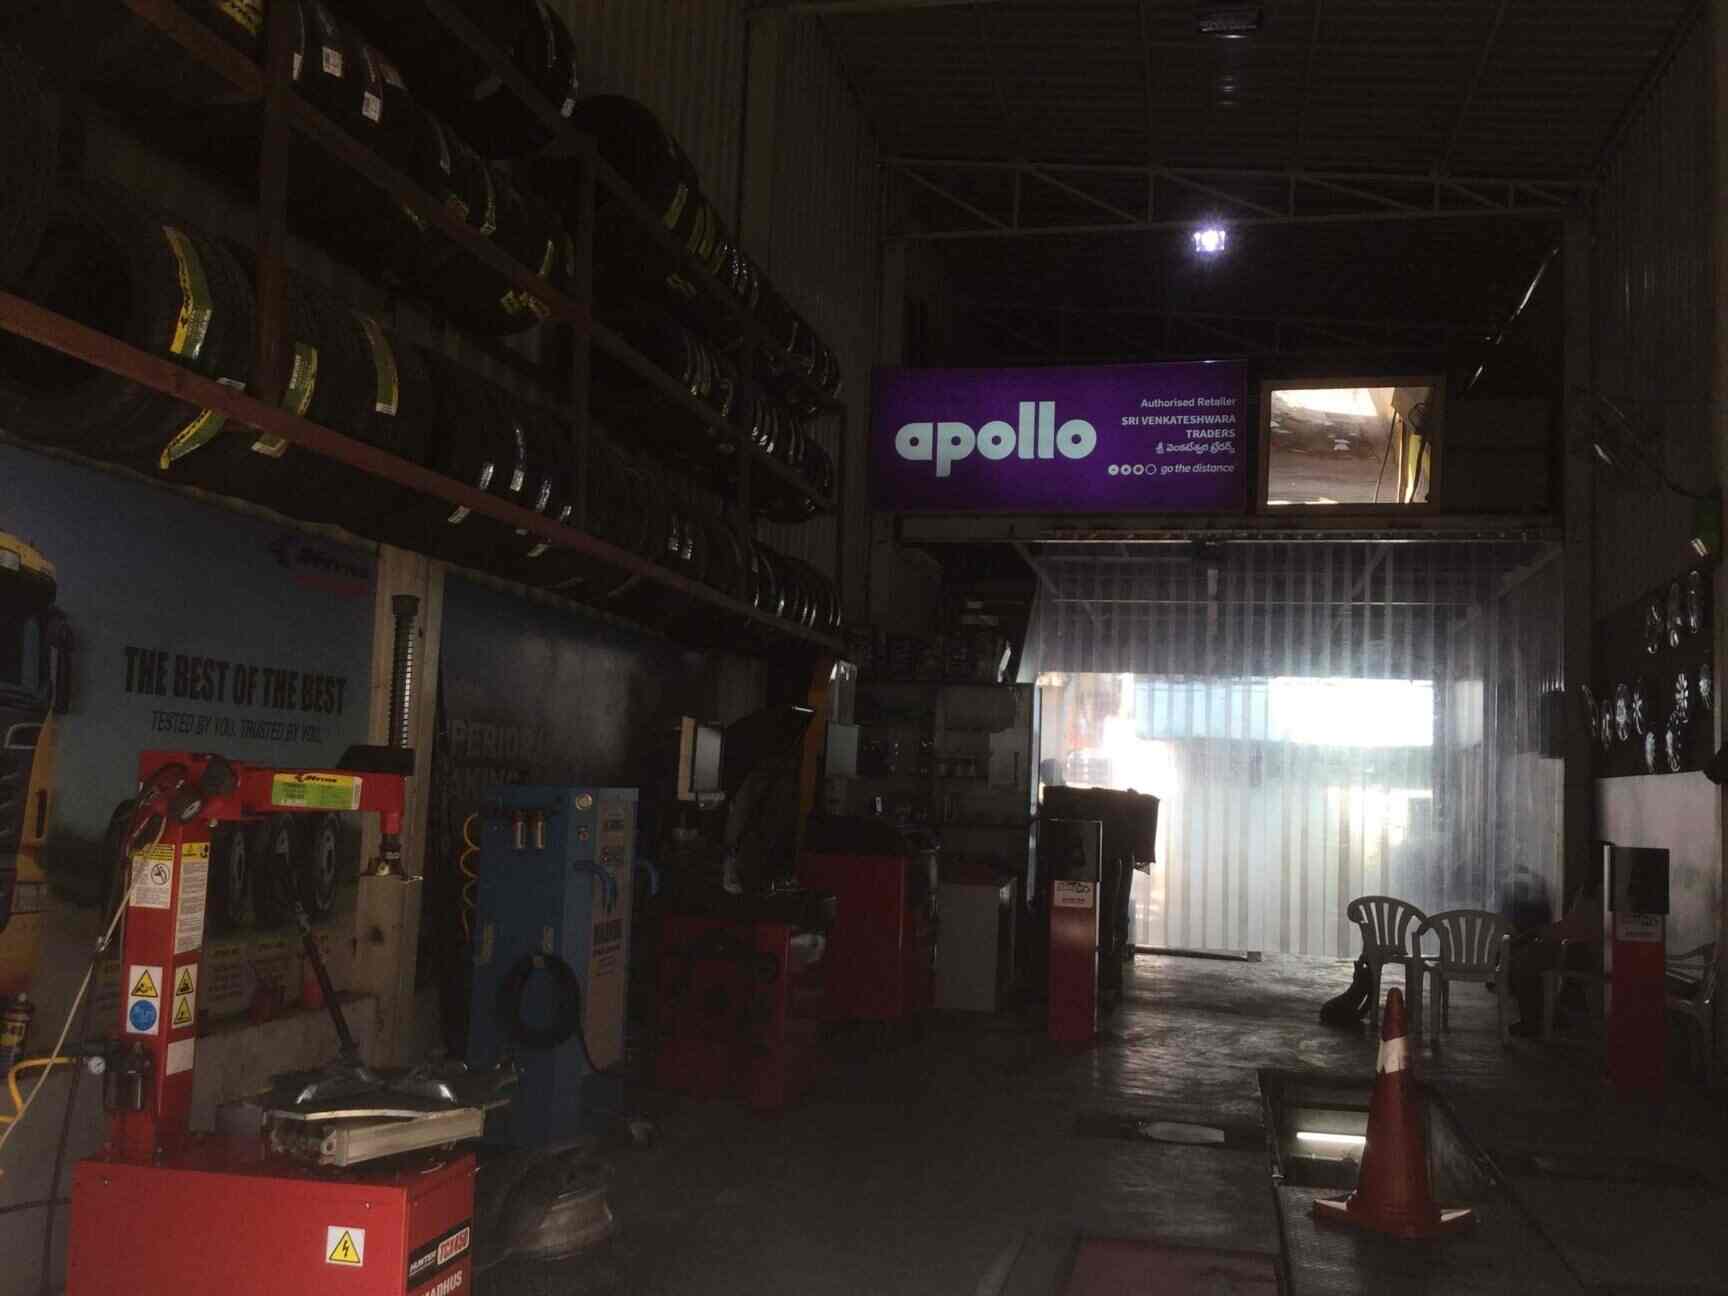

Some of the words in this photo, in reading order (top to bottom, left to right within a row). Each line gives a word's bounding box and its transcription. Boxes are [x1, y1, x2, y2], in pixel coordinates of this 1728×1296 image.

[1140, 398, 1195, 409] Authorised
[1197, 396, 1236, 407] Retailer
[1121, 416, 1139, 426] SRI
[1141, 415, 1237, 426] VENKATESHWARA
[895, 400, 1098, 479] apollo
[1185, 429, 1236, 439] TRADERS
[1160, 465, 1174, 476] go
[1175, 463, 1192, 474] the
[1192, 463, 1236, 474] distance
[124, 645, 169, 697] THE
[173, 654, 231, 703] BEST
[233, 663, 260, 708] OF
[262, 667, 299, 711] THE
[302, 672, 348, 716] BEST
[151, 710, 194, 736] TESTED
[422, 1269, 464, 1296] ADHUS
